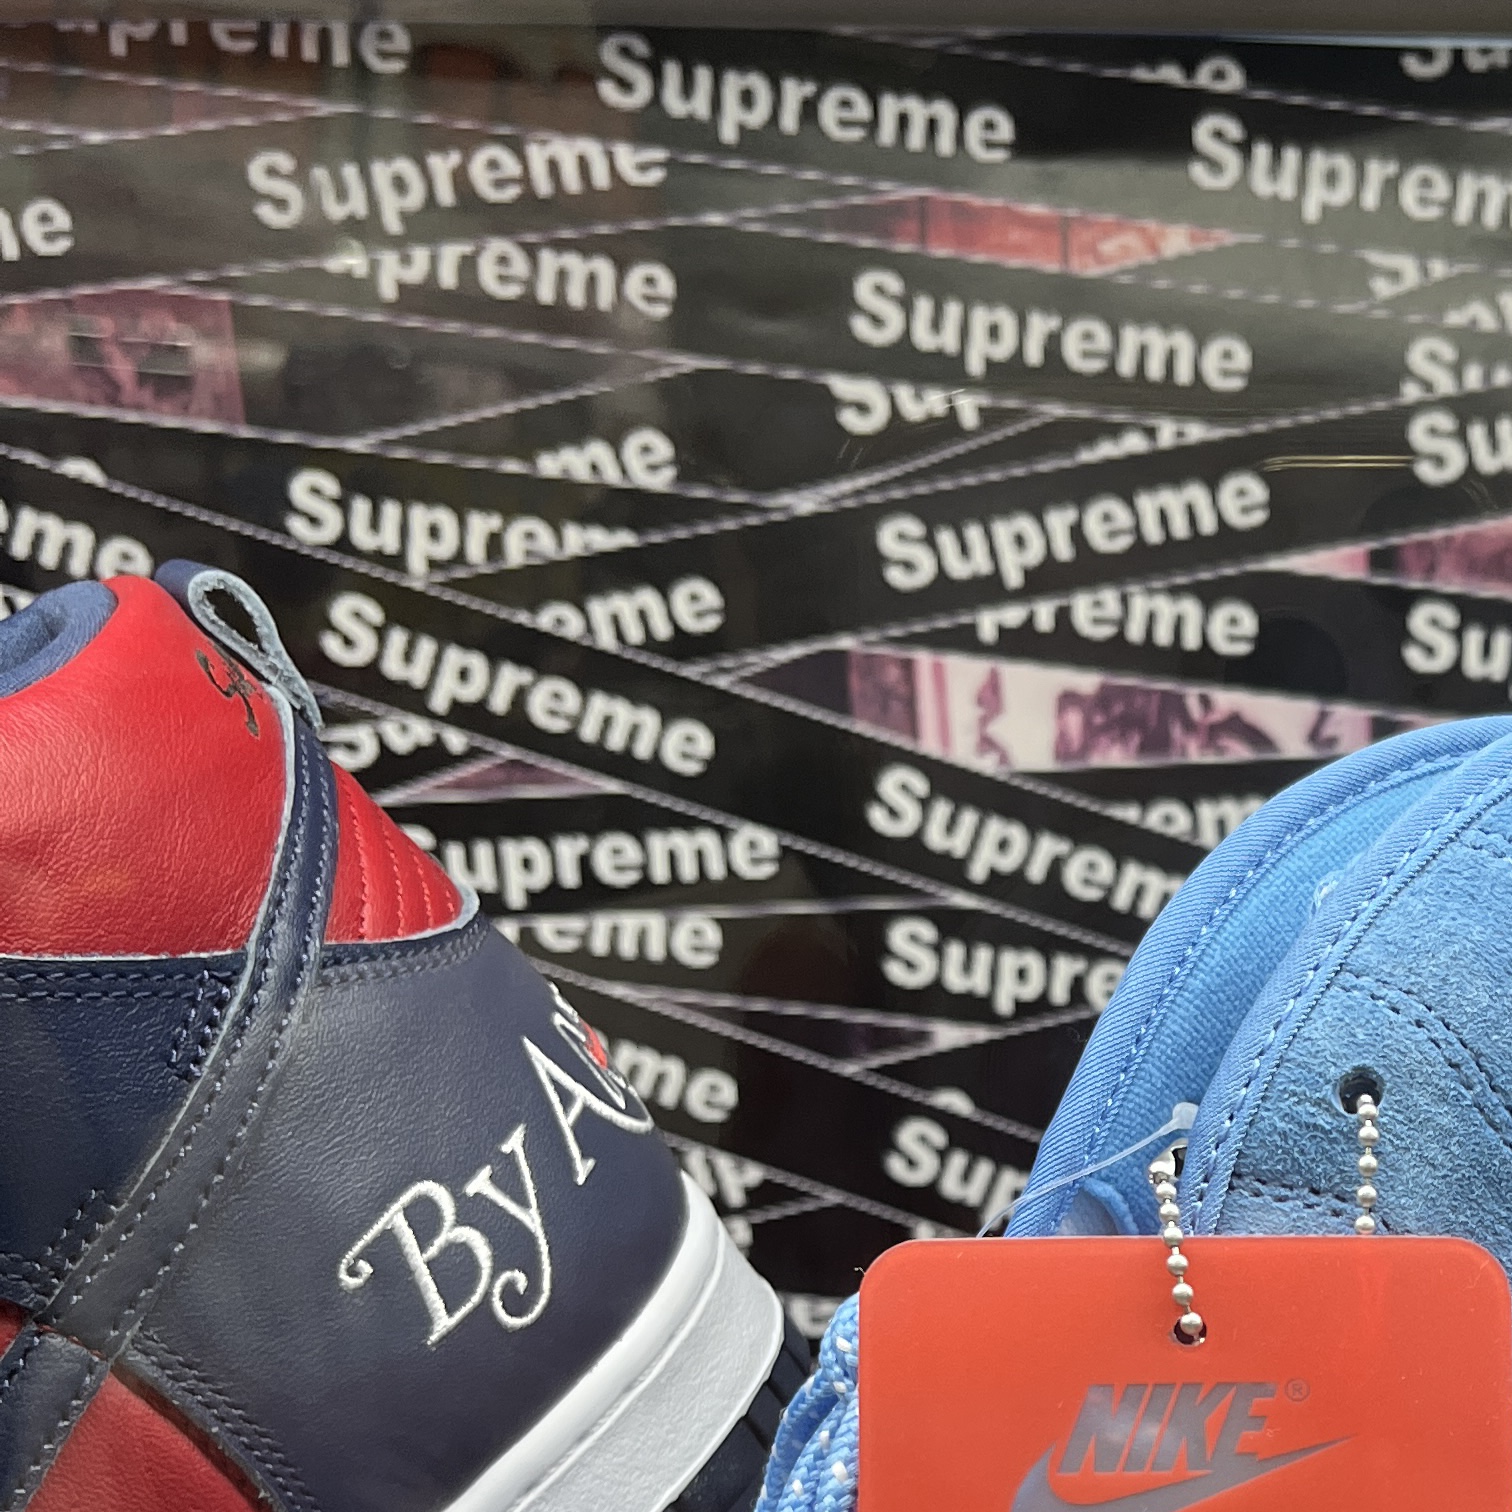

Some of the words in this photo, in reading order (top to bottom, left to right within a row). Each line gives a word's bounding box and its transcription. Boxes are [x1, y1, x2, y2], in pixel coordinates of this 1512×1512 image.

[597, 32, 1016, 165] Supreme
[849, 268, 1253, 393] Supreme
[876, 470, 1271, 592] Supreme
[320, 591, 717, 777] Supreme
[416, 823, 782, 909] upreme
[866, 763, 1188, 921] Suprem
[882, 916, 1118, 1014] Supre
